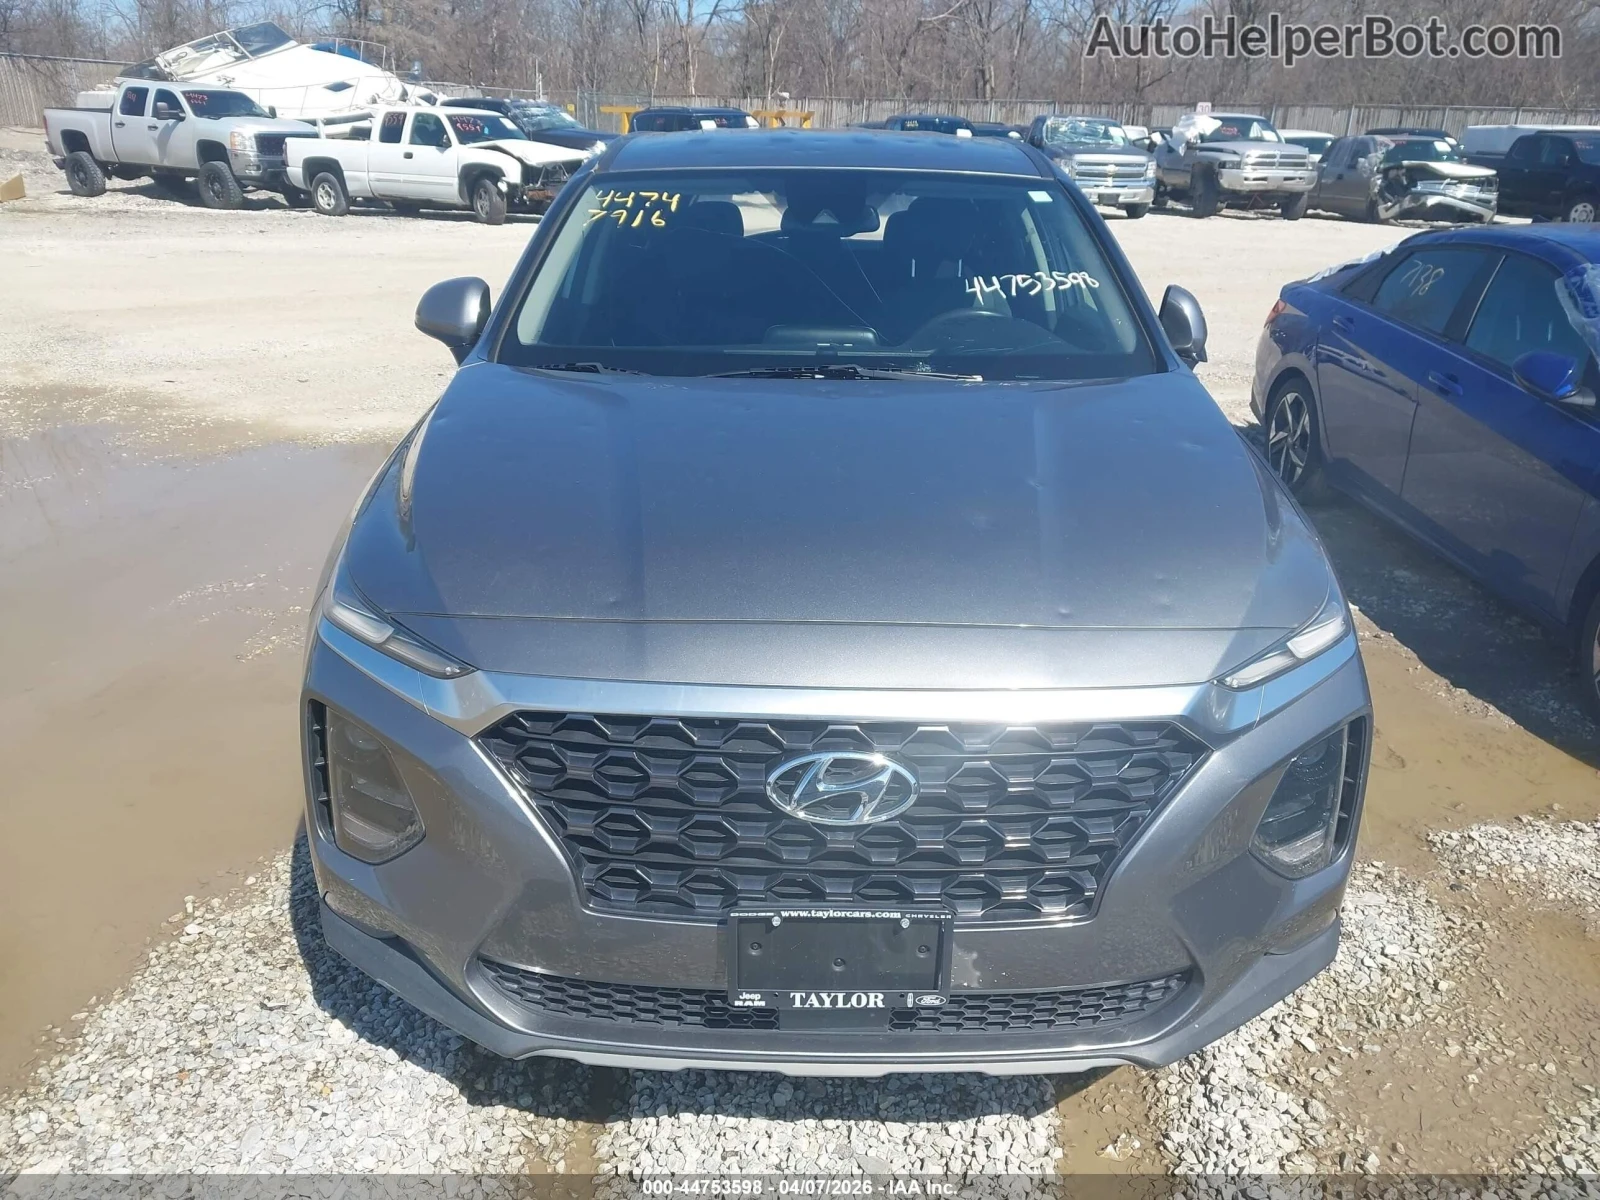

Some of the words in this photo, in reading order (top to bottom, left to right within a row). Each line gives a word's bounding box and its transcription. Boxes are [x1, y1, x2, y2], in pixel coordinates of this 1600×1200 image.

[595, 189, 681, 212] 4474
[582, 209, 666, 228] 7916
[965, 271, 1100, 306] 44753598
[780, 909, 901, 919] www.taylorcars.com
[739, 992, 761, 1001] Jeep
[790, 992, 885, 1008] TAYLOR
